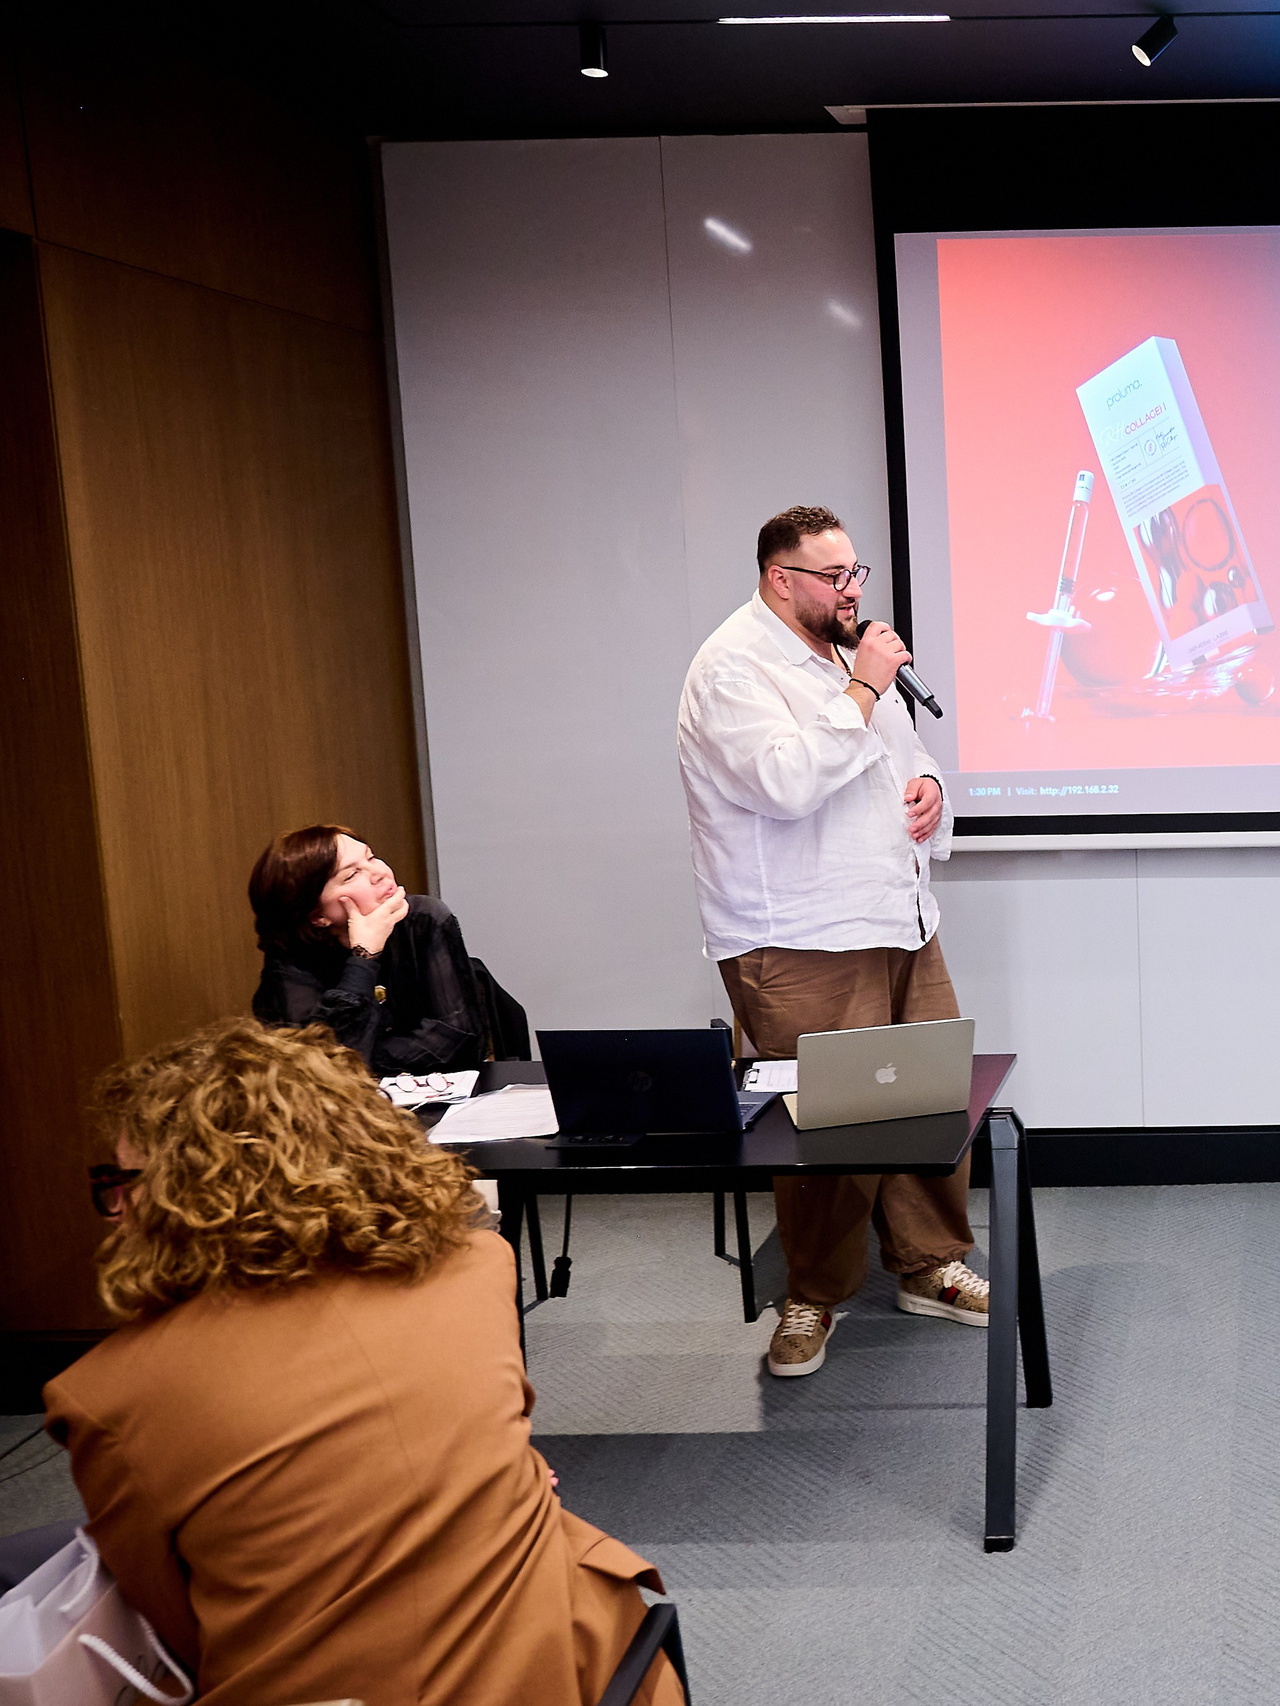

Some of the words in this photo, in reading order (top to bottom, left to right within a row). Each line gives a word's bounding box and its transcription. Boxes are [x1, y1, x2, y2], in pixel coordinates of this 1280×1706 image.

[968, 787, 986, 796] 1:30
[987, 787, 1001, 796] PM
[1015, 787, 1037, 796] Visit:
